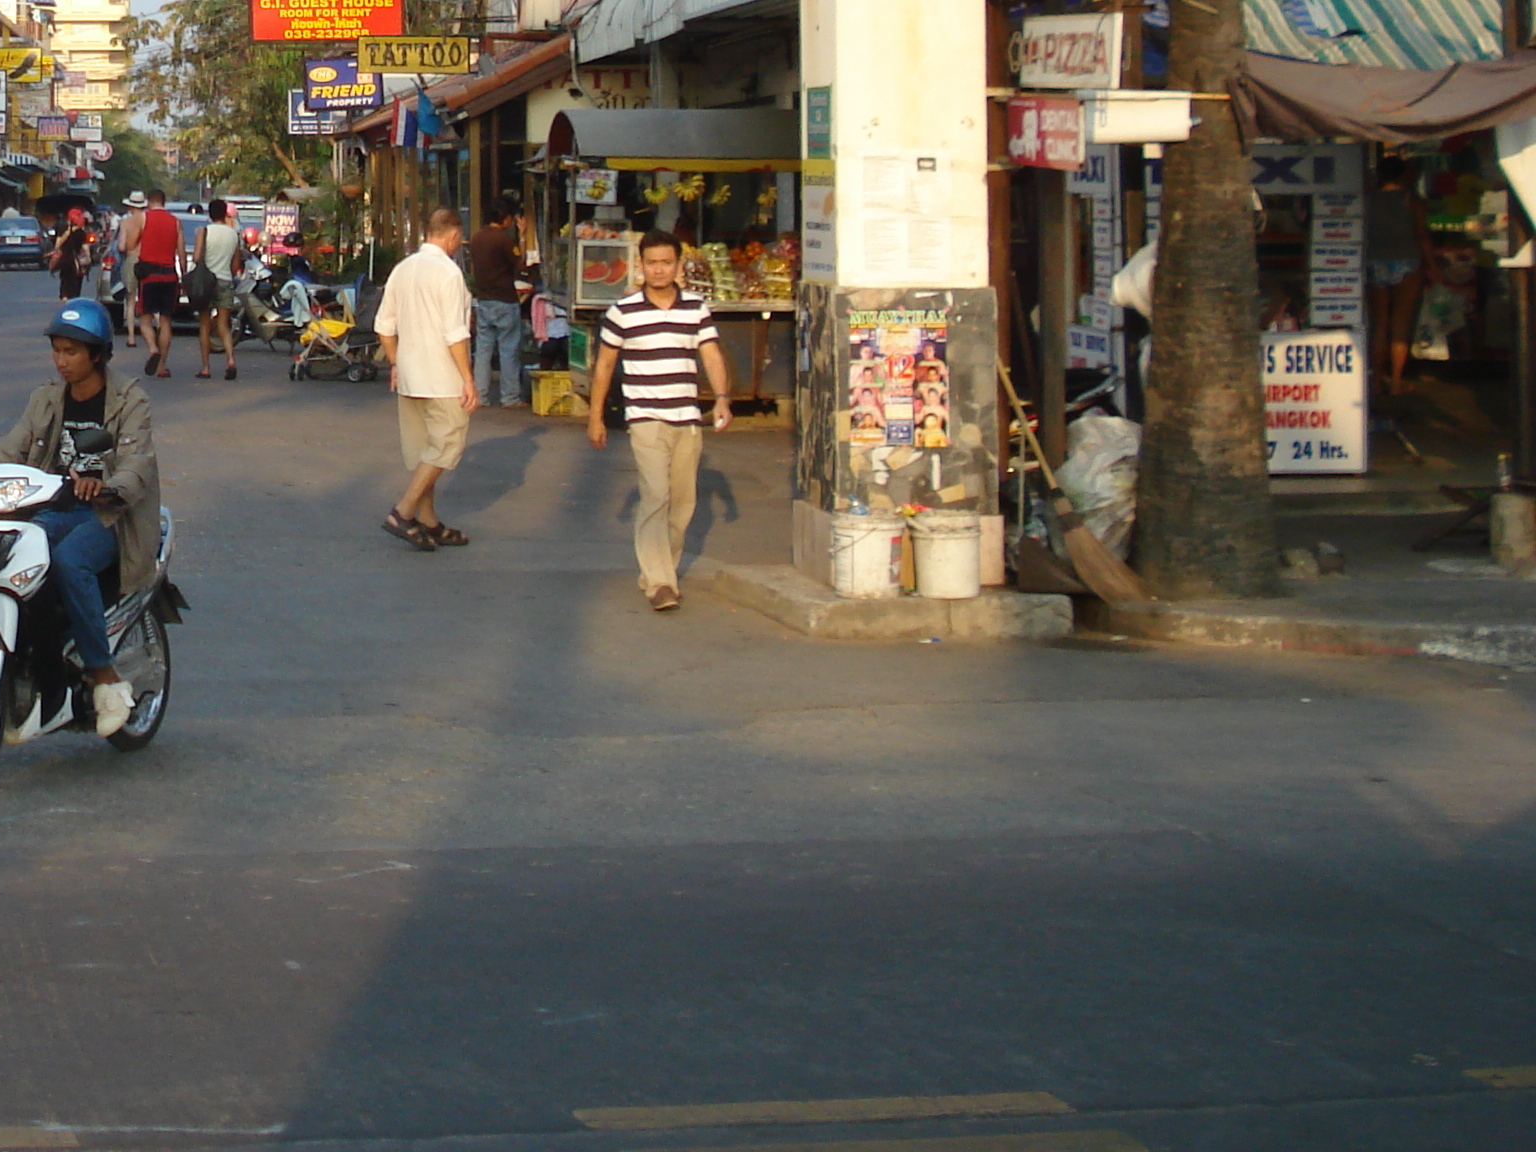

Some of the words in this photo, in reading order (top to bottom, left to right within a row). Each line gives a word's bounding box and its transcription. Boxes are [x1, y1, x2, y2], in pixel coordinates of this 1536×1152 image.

[279, 9, 313, 18] ROOM
[316, 8, 339, 17] FOR
[341, 8, 372, 17] RENT
[365, 41, 462, 67] TATTOO
[1044, 31, 1110, 75] PIZZA
[310, 84, 376, 99] FRIEND
[326, 97, 374, 107] PROPERTY
[266, 214, 296, 226] NOW
[885, 353, 915, 379] 12
[1285, 344, 1353, 374] SERVICE
[1265, 384, 1321, 403] IRPORT
[1266, 410, 1333, 430] ANGKOK
[1293, 440, 1313, 460] 24
[1319, 440, 1348, 460] Hrs.
